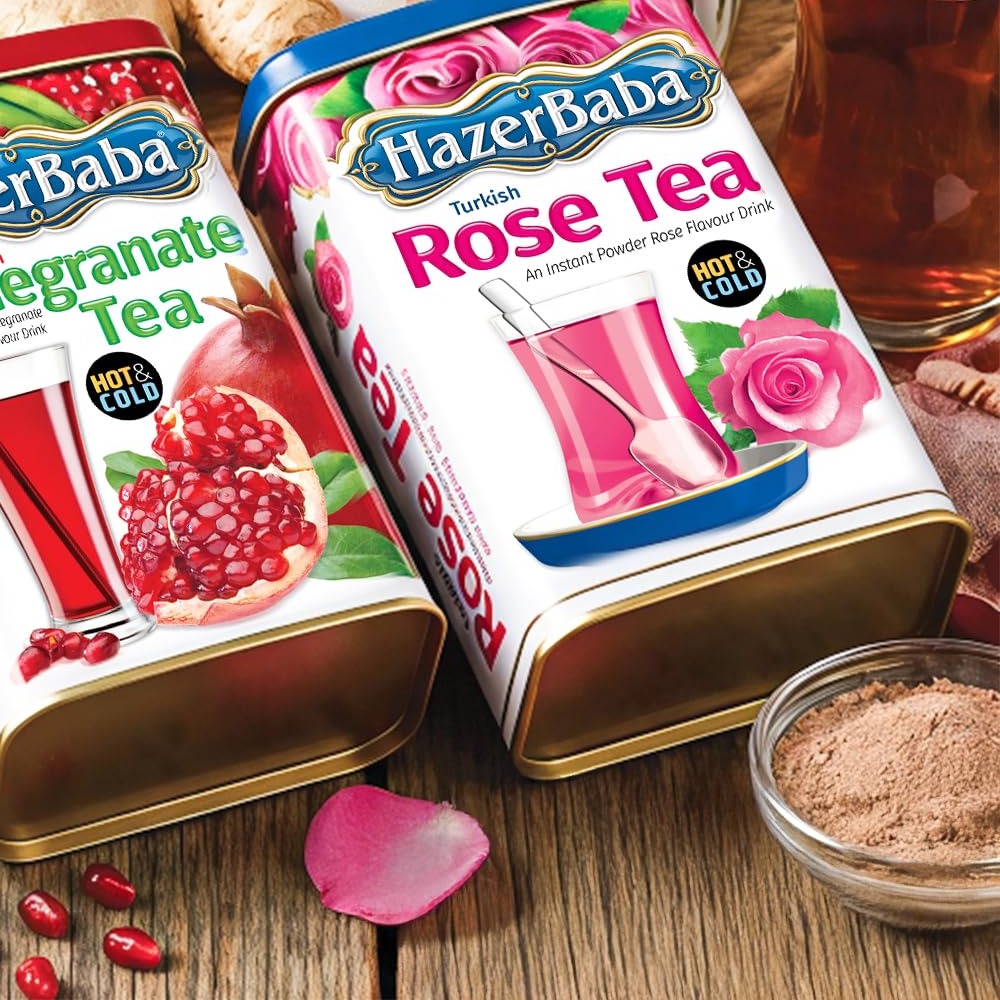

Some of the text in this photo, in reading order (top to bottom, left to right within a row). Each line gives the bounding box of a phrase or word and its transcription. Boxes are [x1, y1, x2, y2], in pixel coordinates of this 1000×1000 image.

[377, 69, 692, 182] HazerBaba
[392, 149, 762, 289] Rose Tea
[448, 185, 521, 217] Turkish
[524, 200, 775, 282] An Instant Powder Rose Flavour Drink
[79, 288, 204, 346] Tea
[701, 267, 763, 300] COLD
[22, 323, 48, 343] Drink
[99, 381, 160, 413] COLD
[352, 324, 411, 484] Tea
[417, 473, 506, 672] Rose
